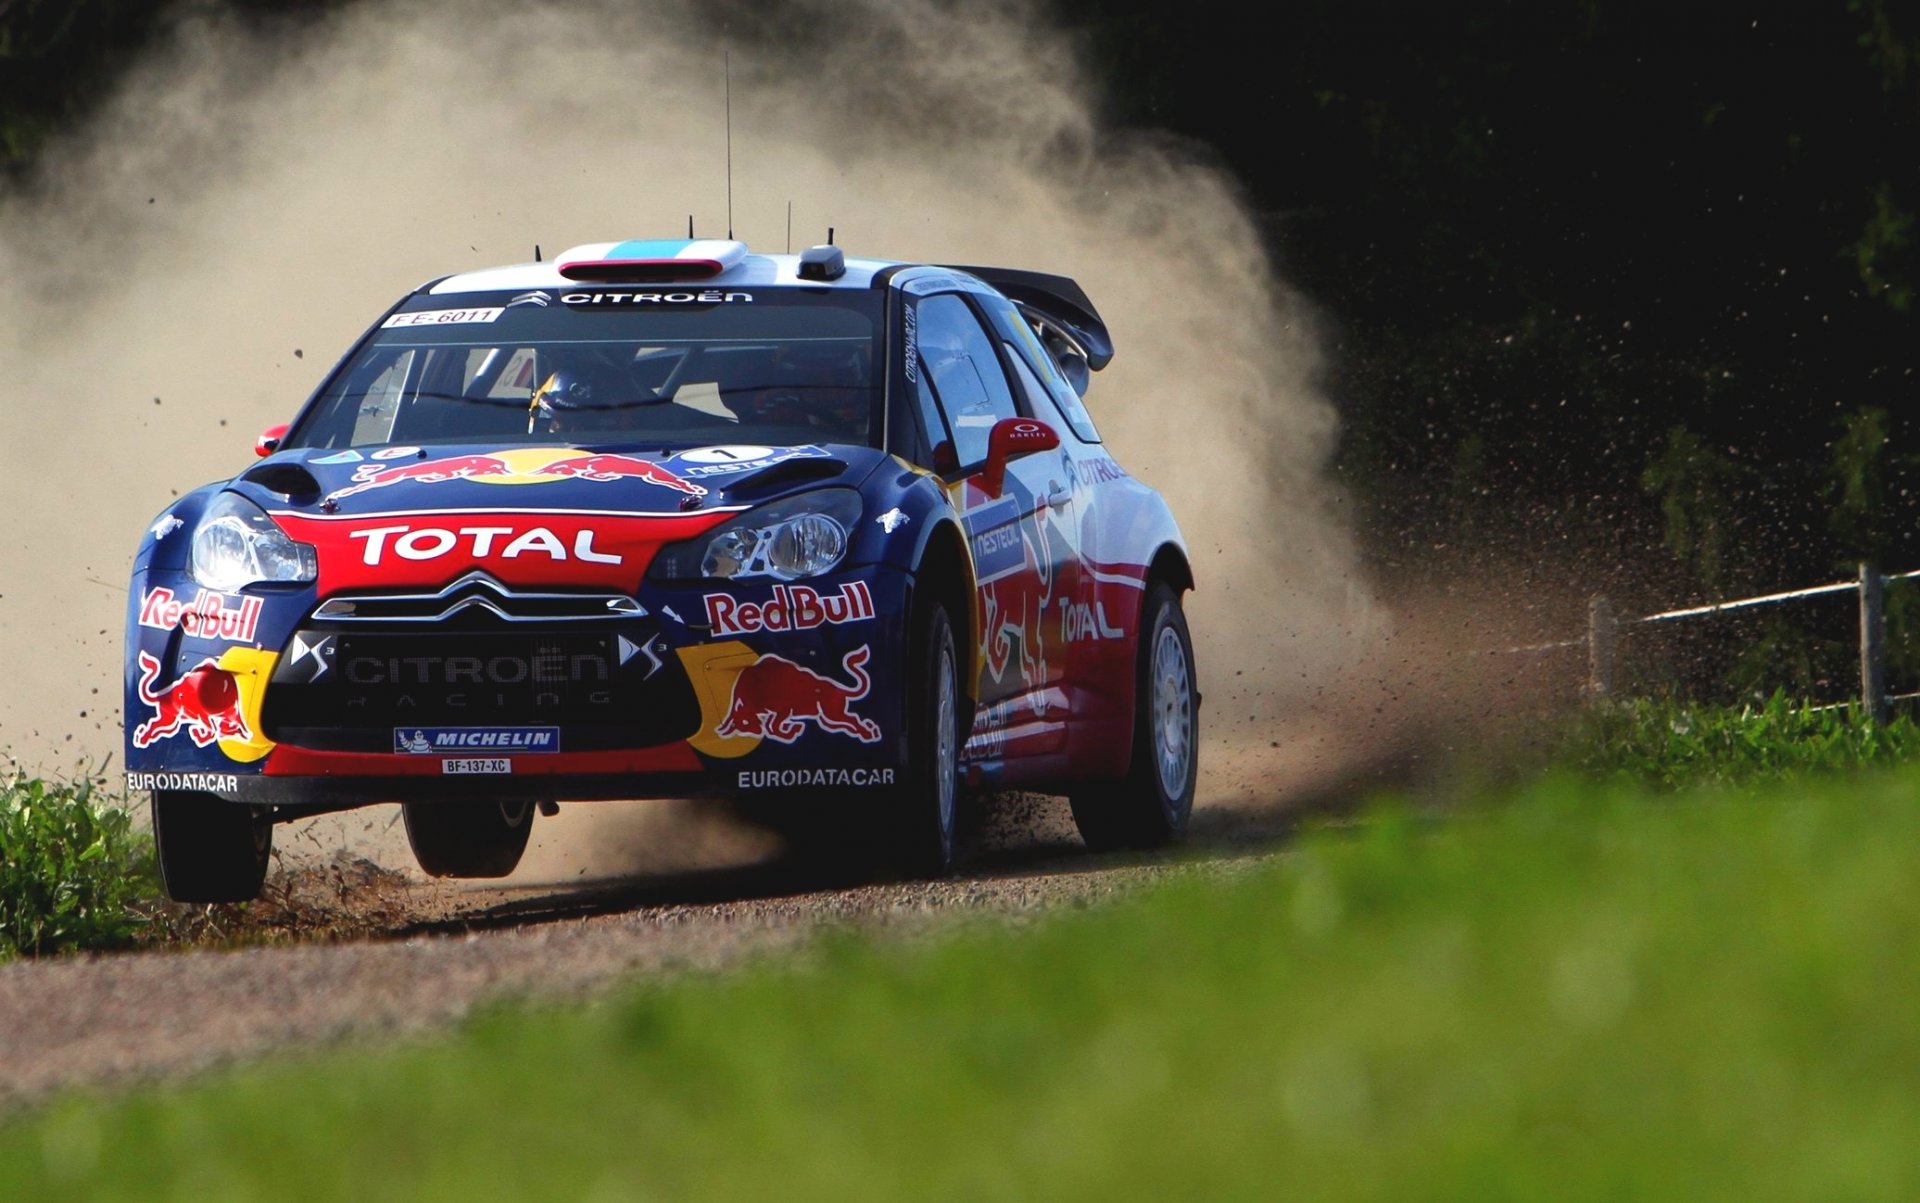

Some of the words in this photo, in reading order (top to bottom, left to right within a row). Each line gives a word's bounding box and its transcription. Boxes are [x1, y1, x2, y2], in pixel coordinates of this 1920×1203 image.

[560, 290, 753, 304] CITROËN
[391, 310, 492, 326] FE-6011
[711, 449, 739, 459] 1
[349, 525, 623, 566] TOTAL
[1059, 597, 1125, 643] TOTAL
[435, 733, 551, 746] MICHELIN
[448, 760, 506, 773] BF-137-XC
[127, 773, 238, 792] EURODATACAR
[738, 768, 895, 788] EURODATACAR
